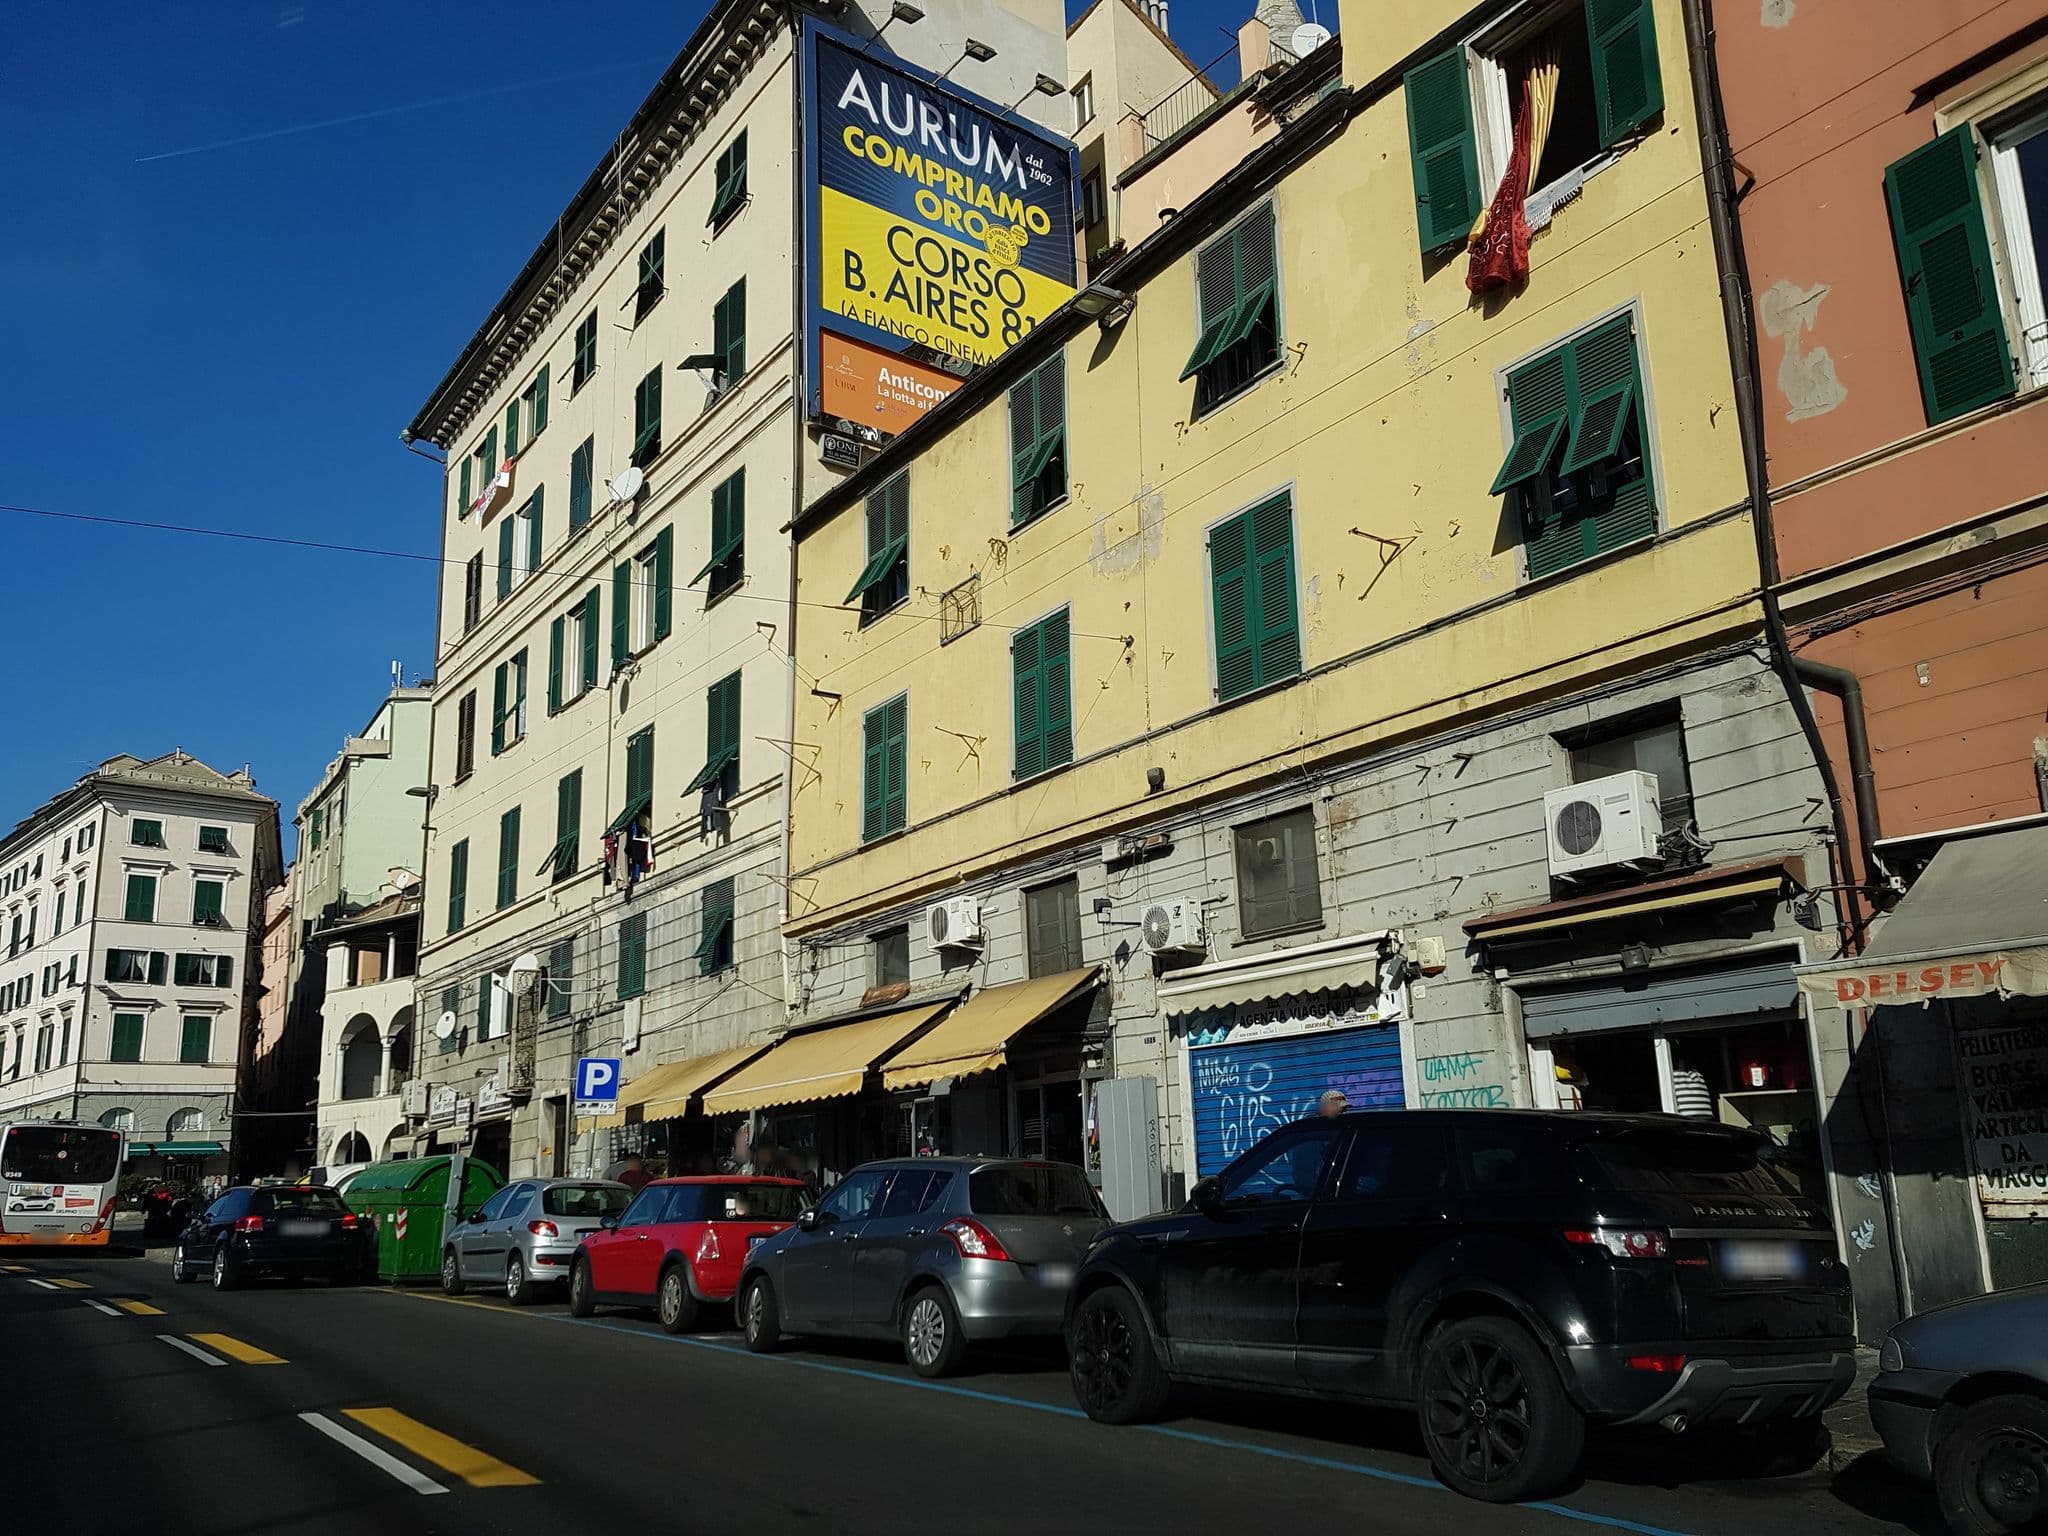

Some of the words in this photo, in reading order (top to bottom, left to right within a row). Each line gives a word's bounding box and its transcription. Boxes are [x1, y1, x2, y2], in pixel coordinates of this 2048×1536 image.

[837, 68, 1028, 191] AURUM
[1025, 153, 1043, 169] dal
[1029, 168, 1053, 187] 1962
[842, 125, 1051, 236] COMPRIAMO
[915, 187, 988, 242] ORO
[886, 225, 1026, 308] CORSO
[844, 248, 877, 300] B.
[883, 267, 990, 339] AIRES
[864, 309, 929, 344] FIANCO
[877, 384, 889, 398] La
[892, 388, 915, 406] lotta
[917, 398, 926, 410] al
[836, 440, 860, 455] ONE
[1837, 958, 2006, 1001] DELSEY
[1239, 1009, 1287, 1027] AGENZIA
[584, 1062, 613, 1096] P
[2001, 1141, 2032, 1163] DA
[1692, 1207, 1758, 1216] RANGE
